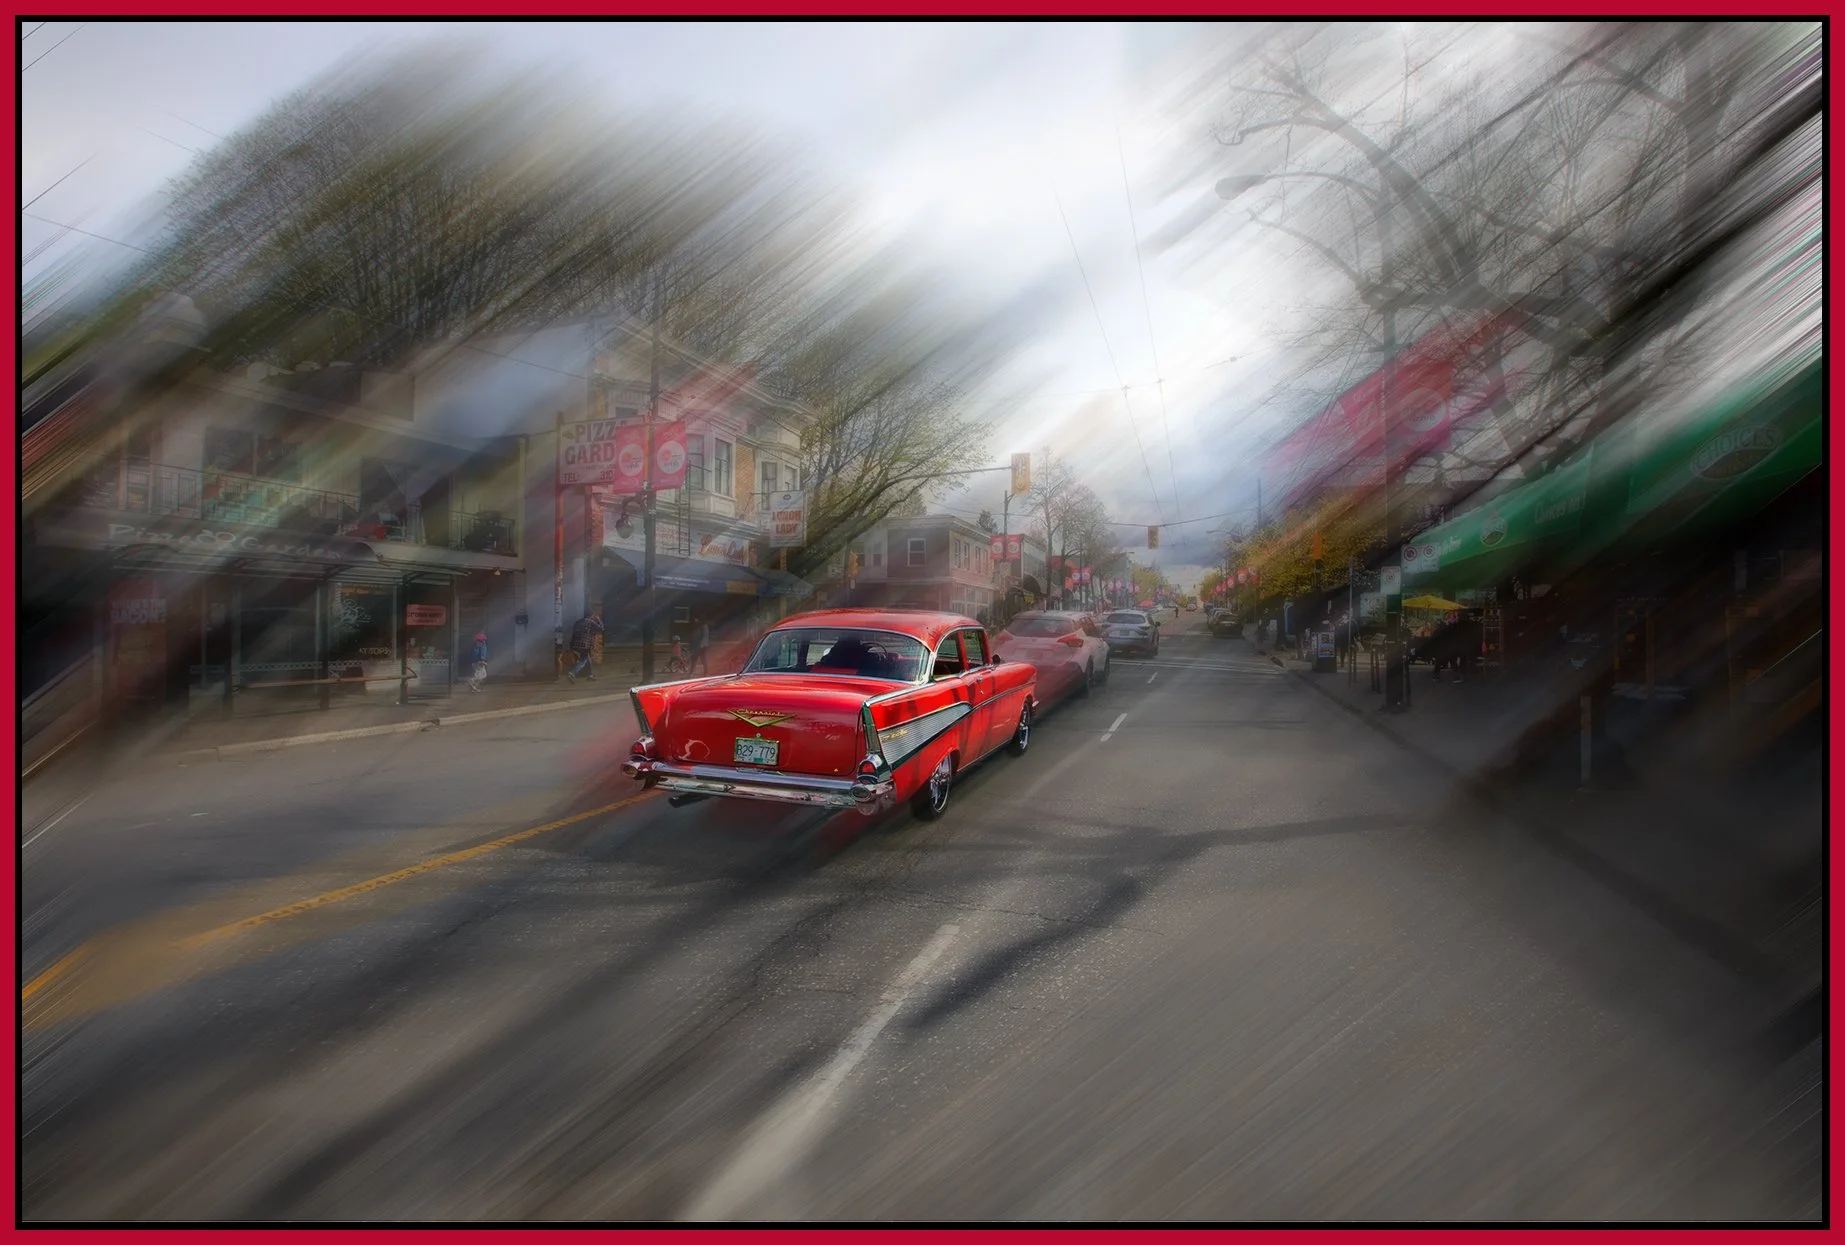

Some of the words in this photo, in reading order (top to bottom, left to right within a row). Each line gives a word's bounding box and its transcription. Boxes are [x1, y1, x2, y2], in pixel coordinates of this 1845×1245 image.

[575, 420, 626, 443] PIZZ
[565, 442, 616, 465] GARD
[1696, 427, 1777, 470] CHOICES
[600, 470, 616, 481] 310
